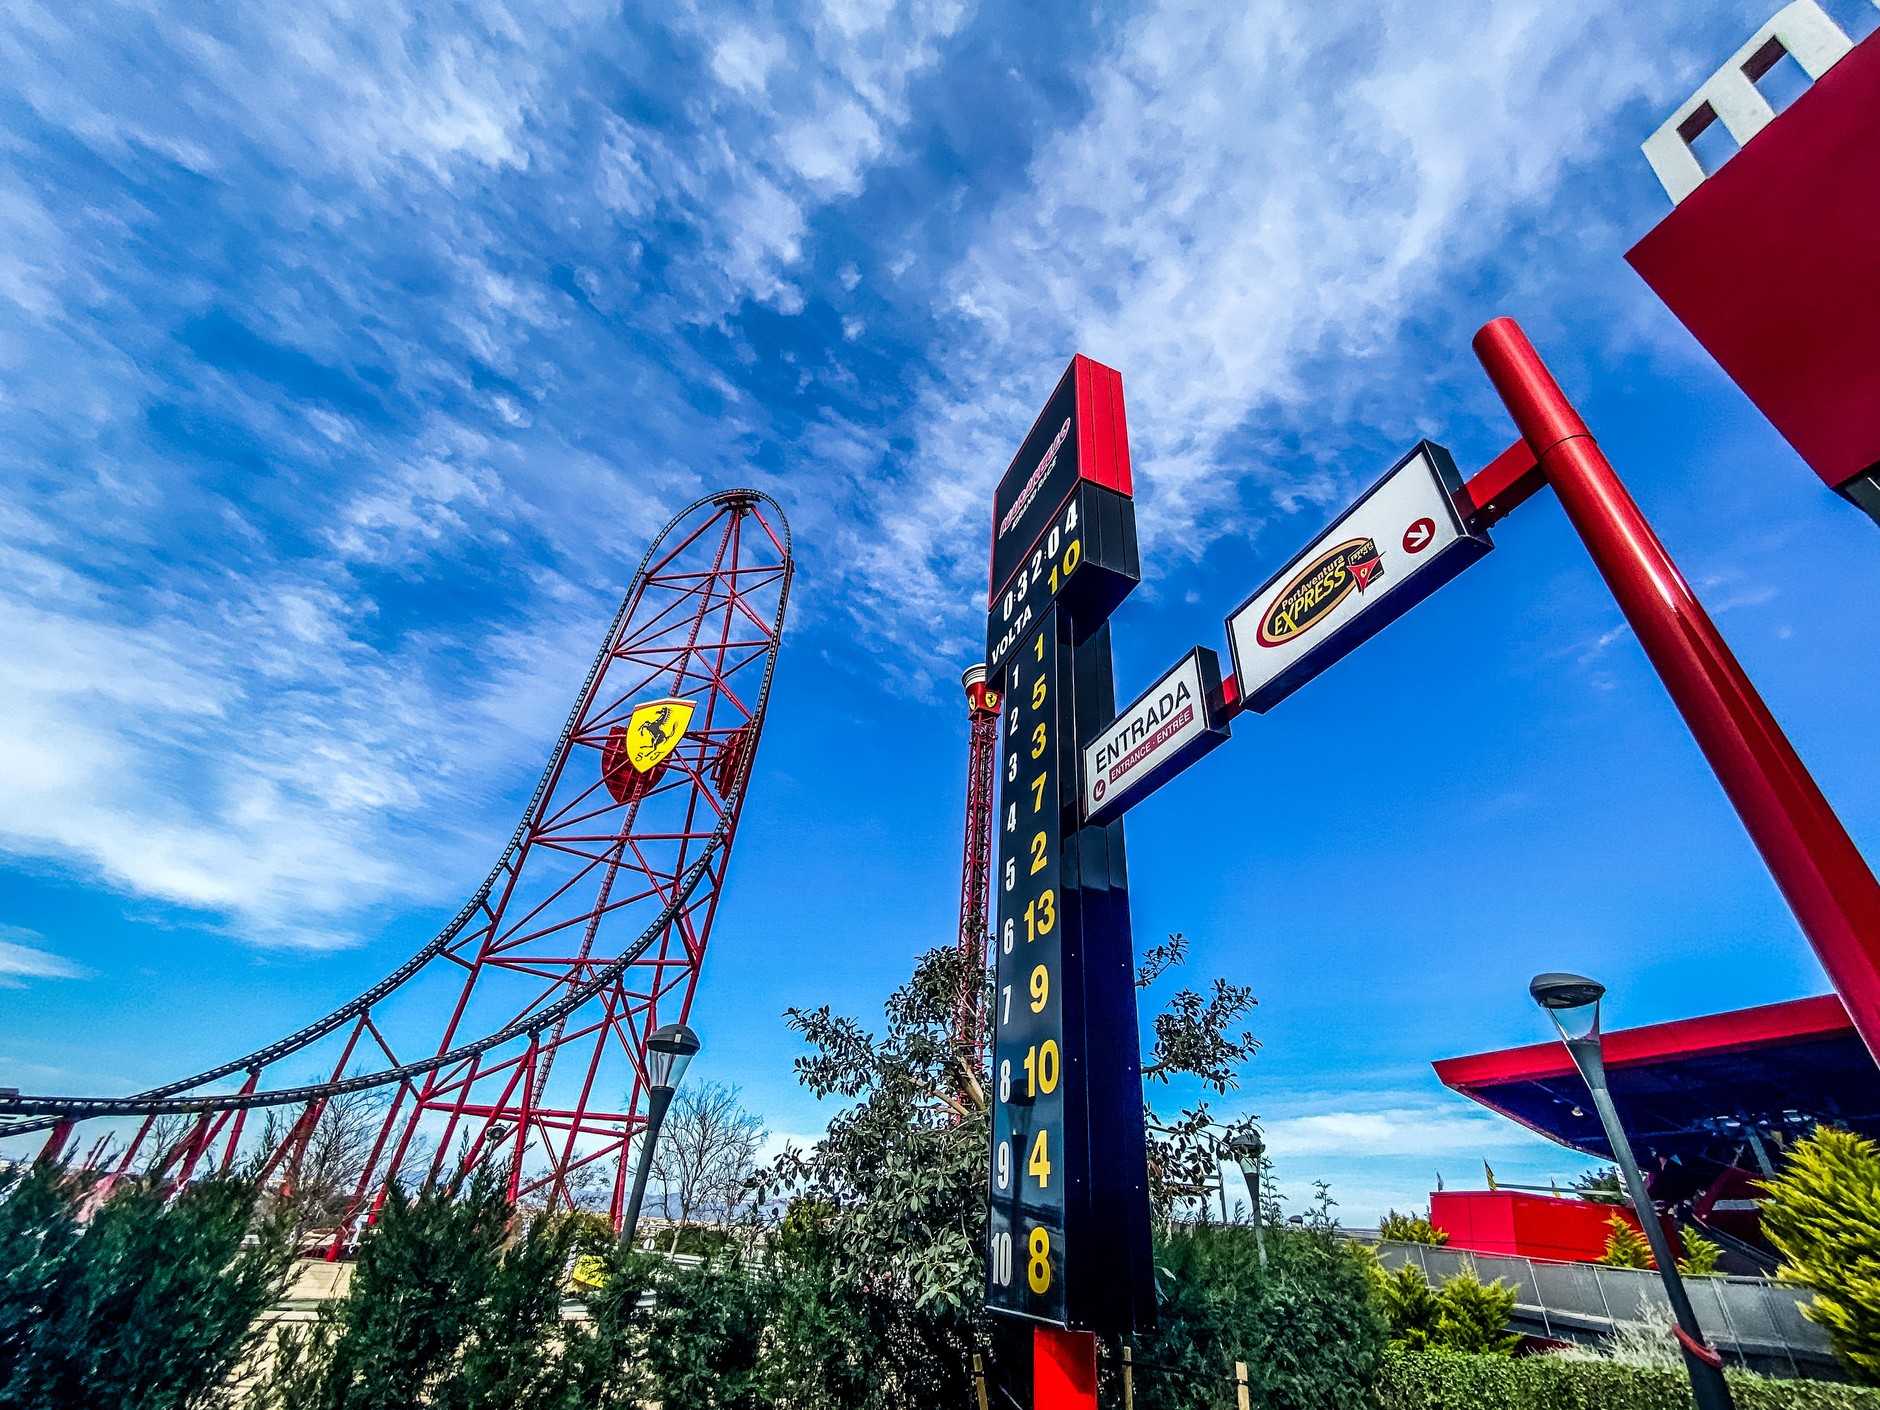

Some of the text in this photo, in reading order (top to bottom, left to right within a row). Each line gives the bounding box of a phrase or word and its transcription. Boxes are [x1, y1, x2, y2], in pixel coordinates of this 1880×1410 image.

[1011, 455, 1057, 532] GRAND RACE
[992, 539, 1081, 665] VOLTA 10
[1274, 561, 1346, 636] EXPRESS
[1281, 554, 1345, 611] PortAventura
[1012, 632, 1044, 689] 1 1
[1010, 673, 1046, 736] 2 5
[1096, 680, 1191, 775] ENTRADA
[1009, 722, 1046, 782] 3 3
[1111, 709, 1191, 781] ENTRANCE ENTRÉE
[1007, 771, 1047, 832] 4 7
[1005, 831, 1047, 892] 5 2
[1003, 889, 1056, 955] 6 13
[1002, 964, 1049, 1026] 7 9
[1000, 1039, 1059, 1103] 8 10
[997, 1129, 1050, 1189] 9 4
[991, 1226, 1050, 1294] 10 8
